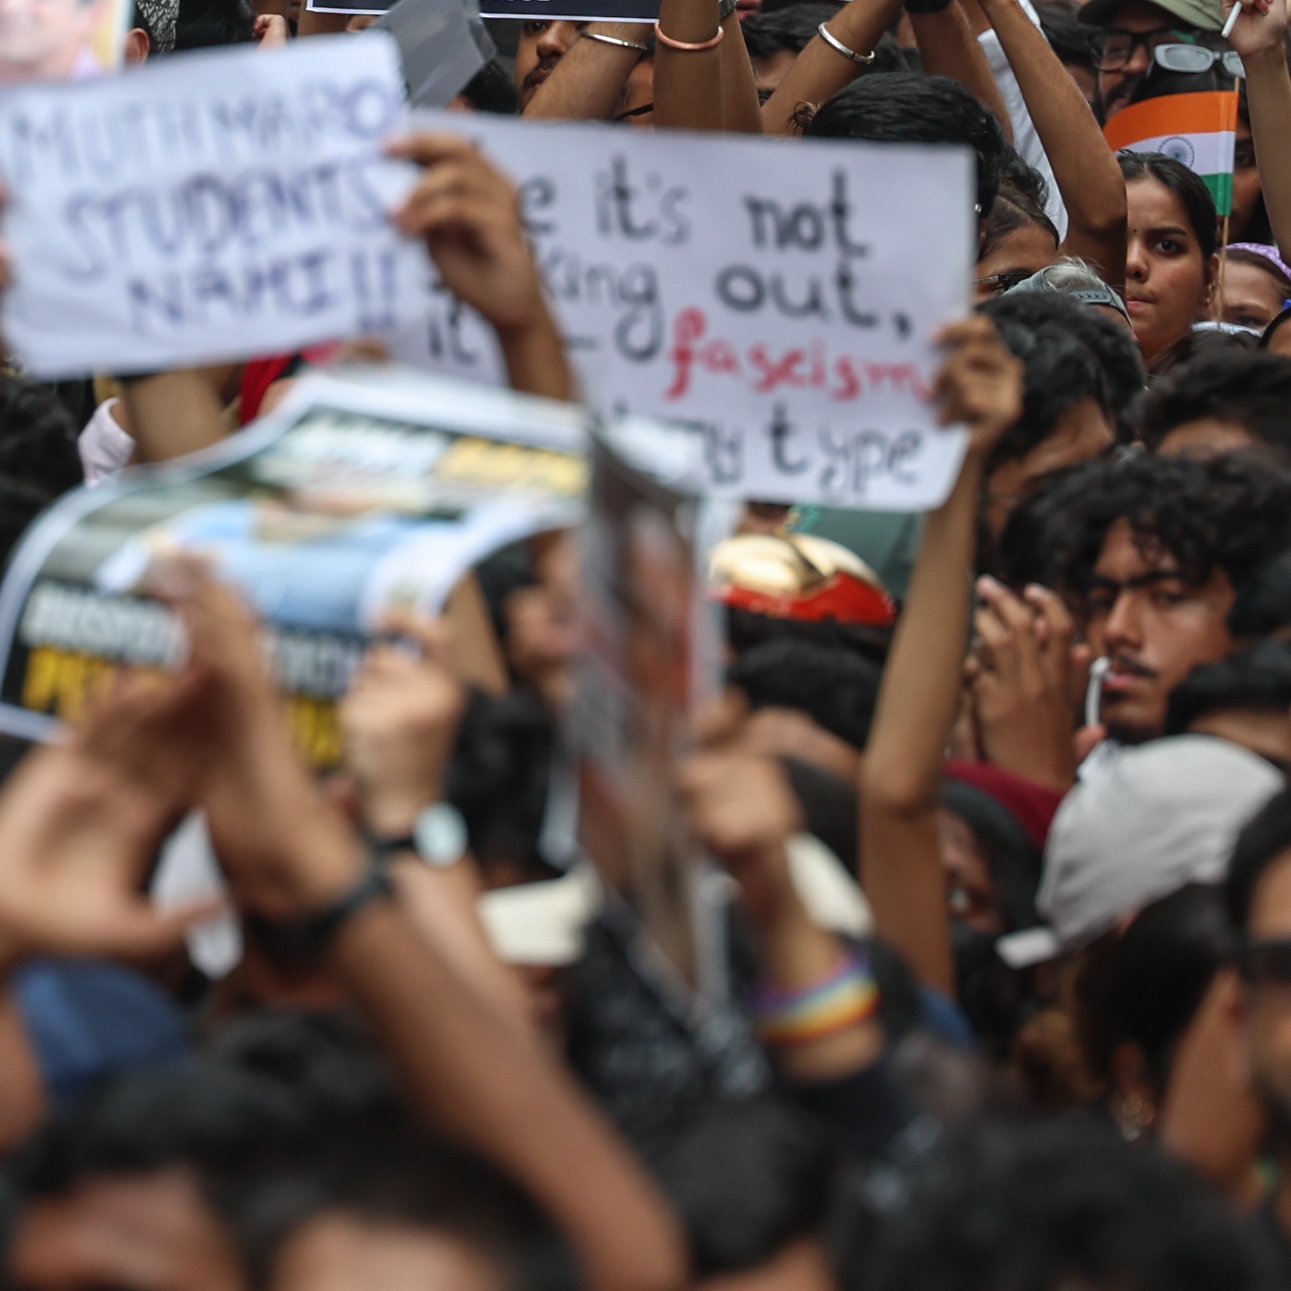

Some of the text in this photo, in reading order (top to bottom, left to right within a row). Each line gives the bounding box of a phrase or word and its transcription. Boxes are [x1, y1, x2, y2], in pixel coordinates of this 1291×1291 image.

[62, 153, 395, 281] STUDENTS
[594, 152, 873, 262] it's not
[714, 255, 915, 342] out,
[665, 304, 938, 404] fascism
